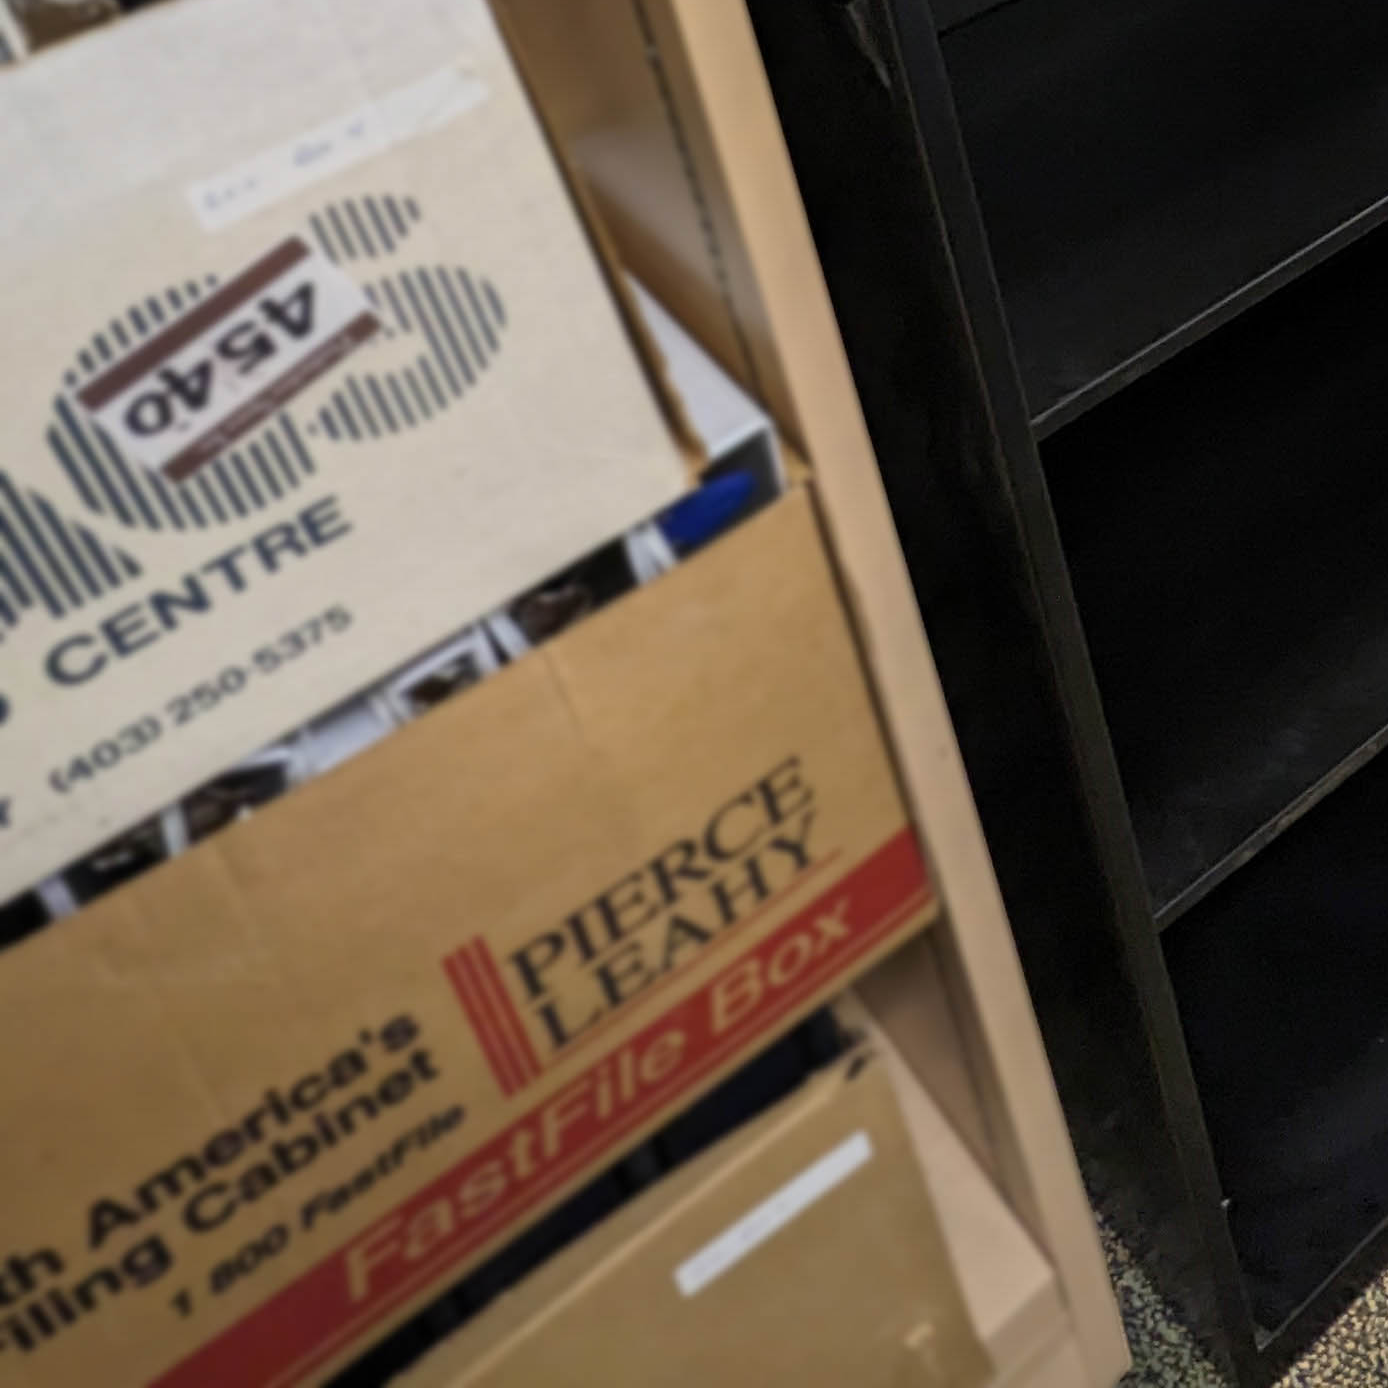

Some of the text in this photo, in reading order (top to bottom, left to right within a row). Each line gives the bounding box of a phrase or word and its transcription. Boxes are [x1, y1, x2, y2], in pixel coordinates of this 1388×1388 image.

[44, 493, 353, 688] CENTRE
[48, 605, 353, 793] (403) 250-5375
[507, 755, 815, 1000] PIERCE
[536, 810, 817, 1050] LEAHY
[0, 1048, 440, 1353] iling Cabinet
[86, 1012, 421, 1251] America's
[170, 1104, 467, 1318] 1 800 FastFile
[344, 897, 853, 1304] FastFile Box
